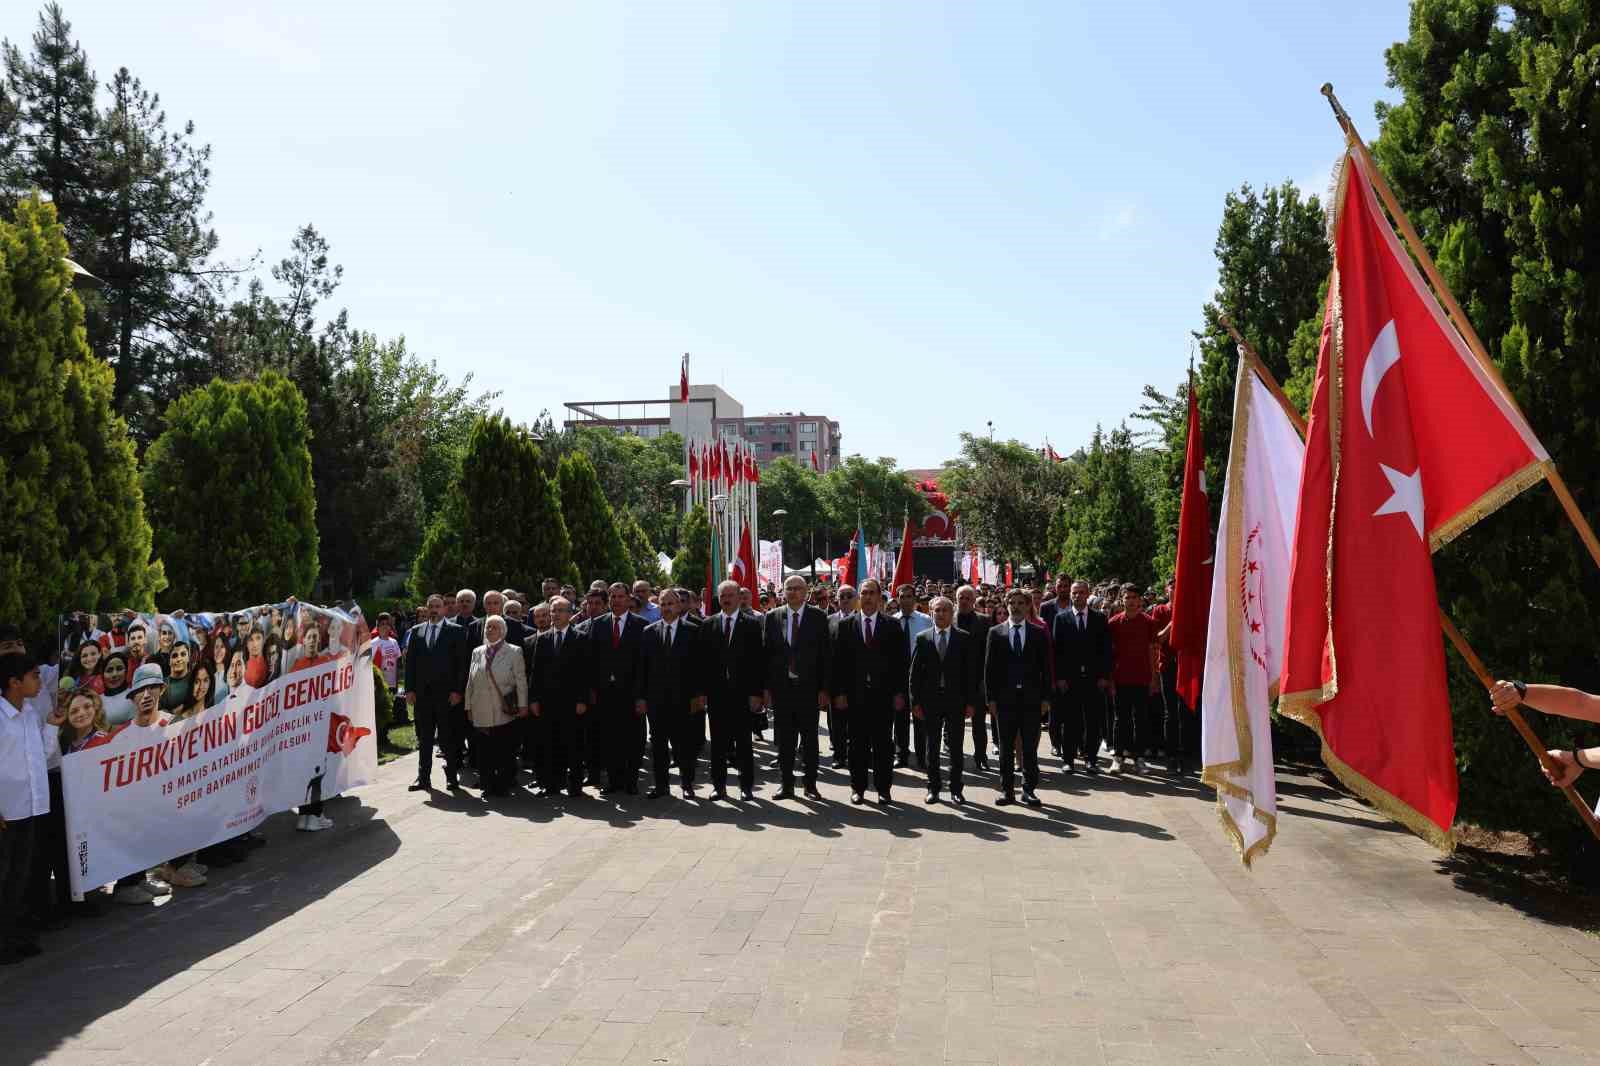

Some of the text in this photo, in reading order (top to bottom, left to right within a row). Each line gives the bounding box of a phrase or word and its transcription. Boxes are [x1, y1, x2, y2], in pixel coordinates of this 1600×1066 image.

[100, 712, 236, 792] TÜRKİYE'NİN
[284, 663, 354, 710] GENÇLİĞ
[162, 781, 173, 796] 19
[177, 765, 208, 789] MAYIS
[314, 710, 325, 721] VE
[176, 787, 203, 809] SPOR
[206, 758, 261, 794] BAYRAMIMIZ
[278, 731, 312, 752] OLSUN!
